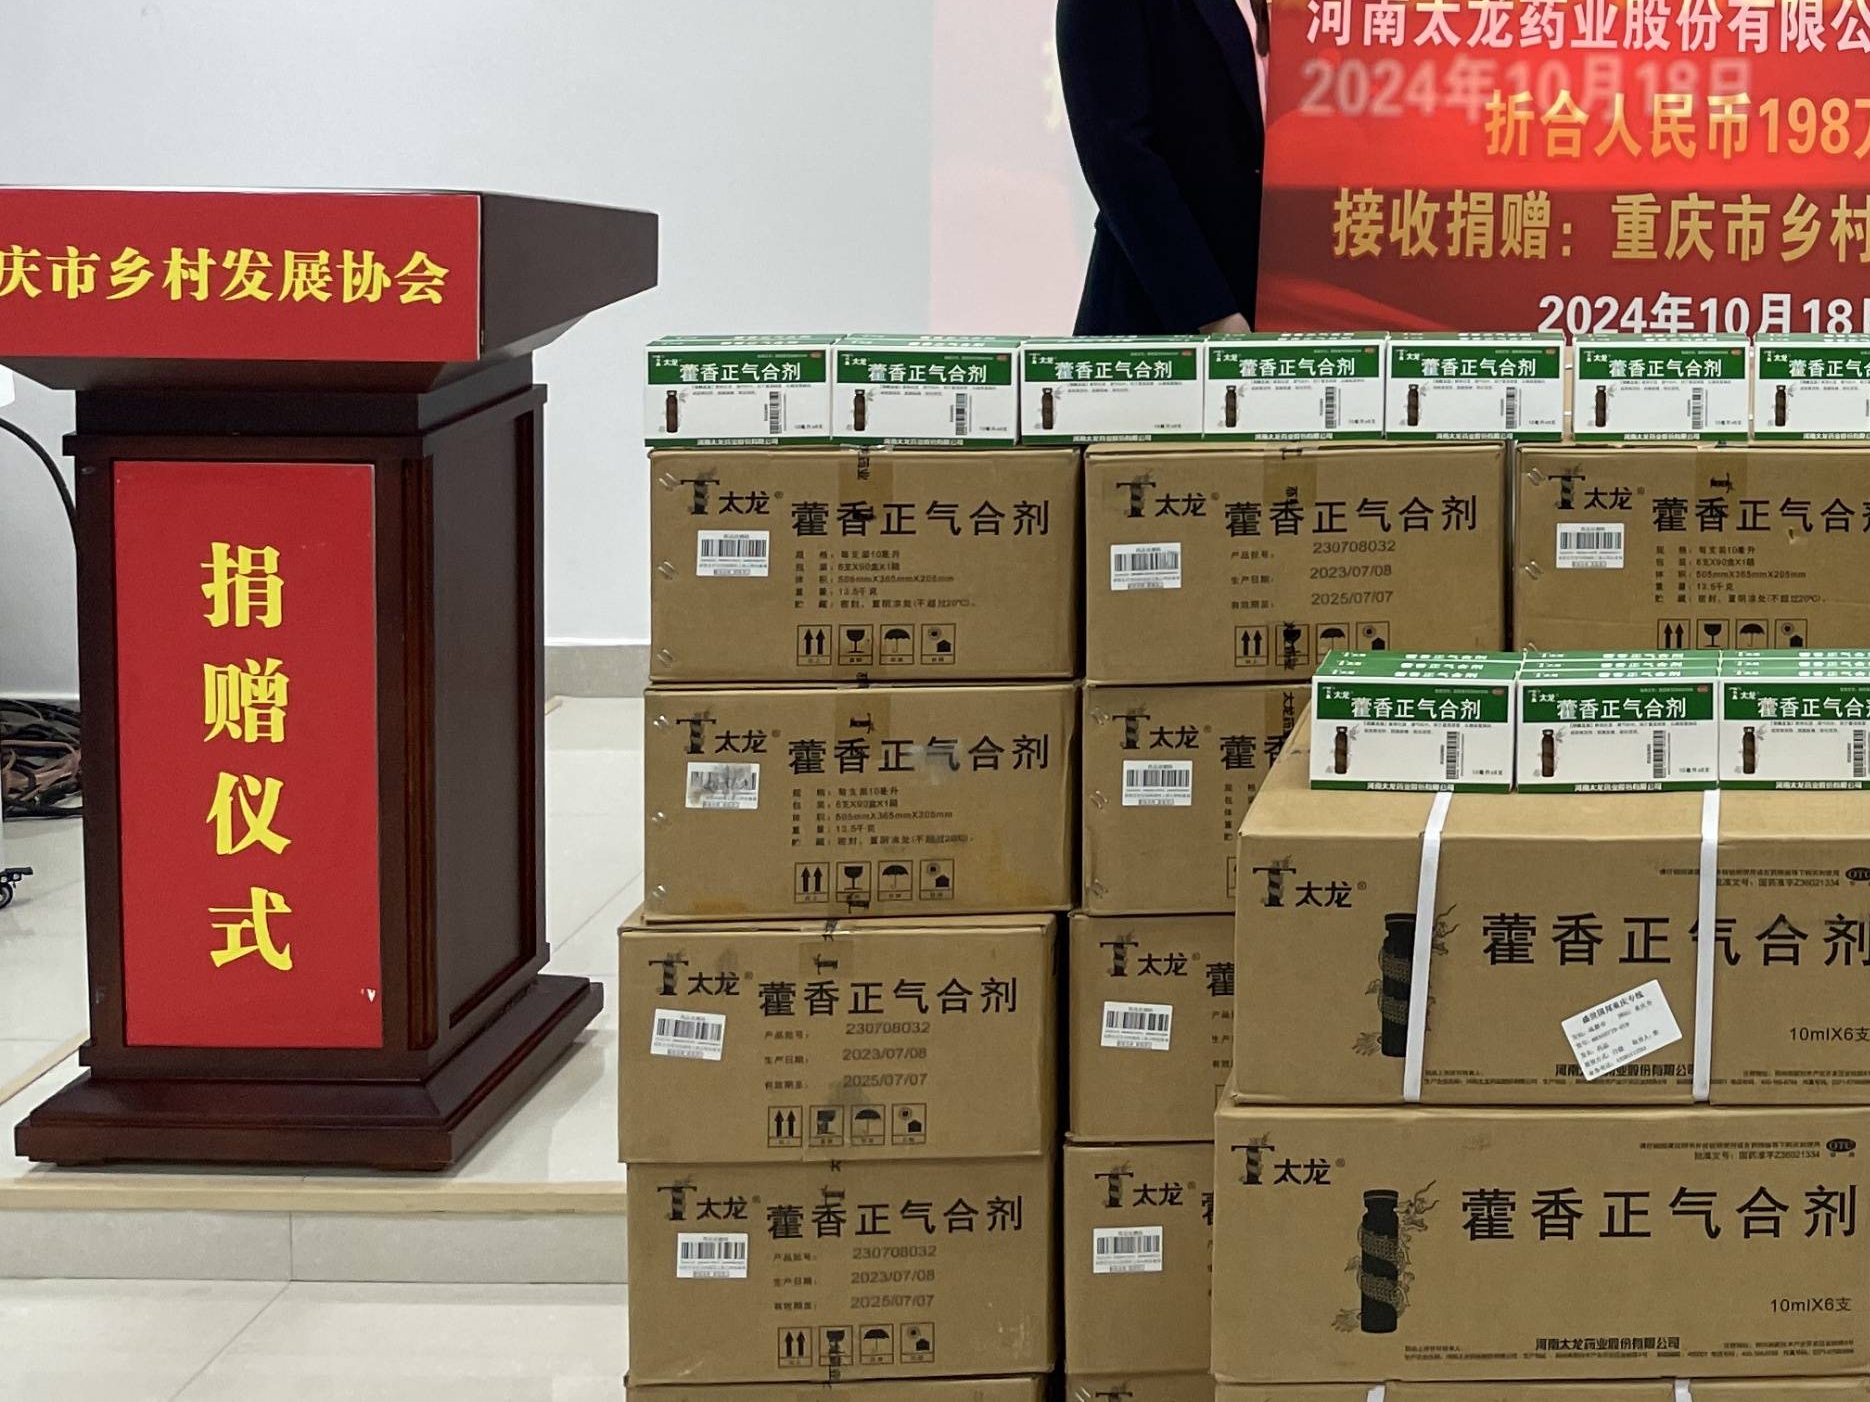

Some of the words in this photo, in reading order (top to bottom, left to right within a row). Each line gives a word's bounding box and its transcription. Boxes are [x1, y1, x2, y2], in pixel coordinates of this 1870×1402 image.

[679, 362, 801, 382] 藿香正气合剂
[867, 362, 987, 383] 藿香正气合剂
[1055, 361, 1173, 380] 藿香正气合剂
[1238, 357, 1356, 377] 藿香正气合剂
[1421, 358, 1536, 377] 藿香正气合剂
[1608, 358, 1723, 378] 藿香正气合剂
[792, 500, 1048, 536] 藿香正气合剂
[1225, 496, 1476, 537] 藿香正气合剂
[1313, 541, 1395, 553] 230708032
[1311, 565, 1391, 579] 2023/07/08
[1312, 591, 1393, 605] 2025/07/07
[1351, 697, 1482, 720] 藿香正气合剂
[1557, 697, 1687, 719] 藿香正气合剂
[201, 542, 293, 972] 捐赠仪式
[789, 733, 1048, 774] 藿香正气合剂
[759, 977, 1016, 1016] 藿香正气合剂
[846, 1022, 930, 1034] 230708032
[843, 1048, 926, 1060] 2023/07/08
[843, 1074, 927, 1088] 2025/07/07
[767, 1194, 1021, 1239] 藿香正气合剂
[1463, 1185, 1856, 1240] 藿香正气合剂
[854, 1246, 936, 1259] 230708032
[852, 1270, 934, 1283] 2023/07/08
[851, 1294, 934, 1308] 2025/07/07
